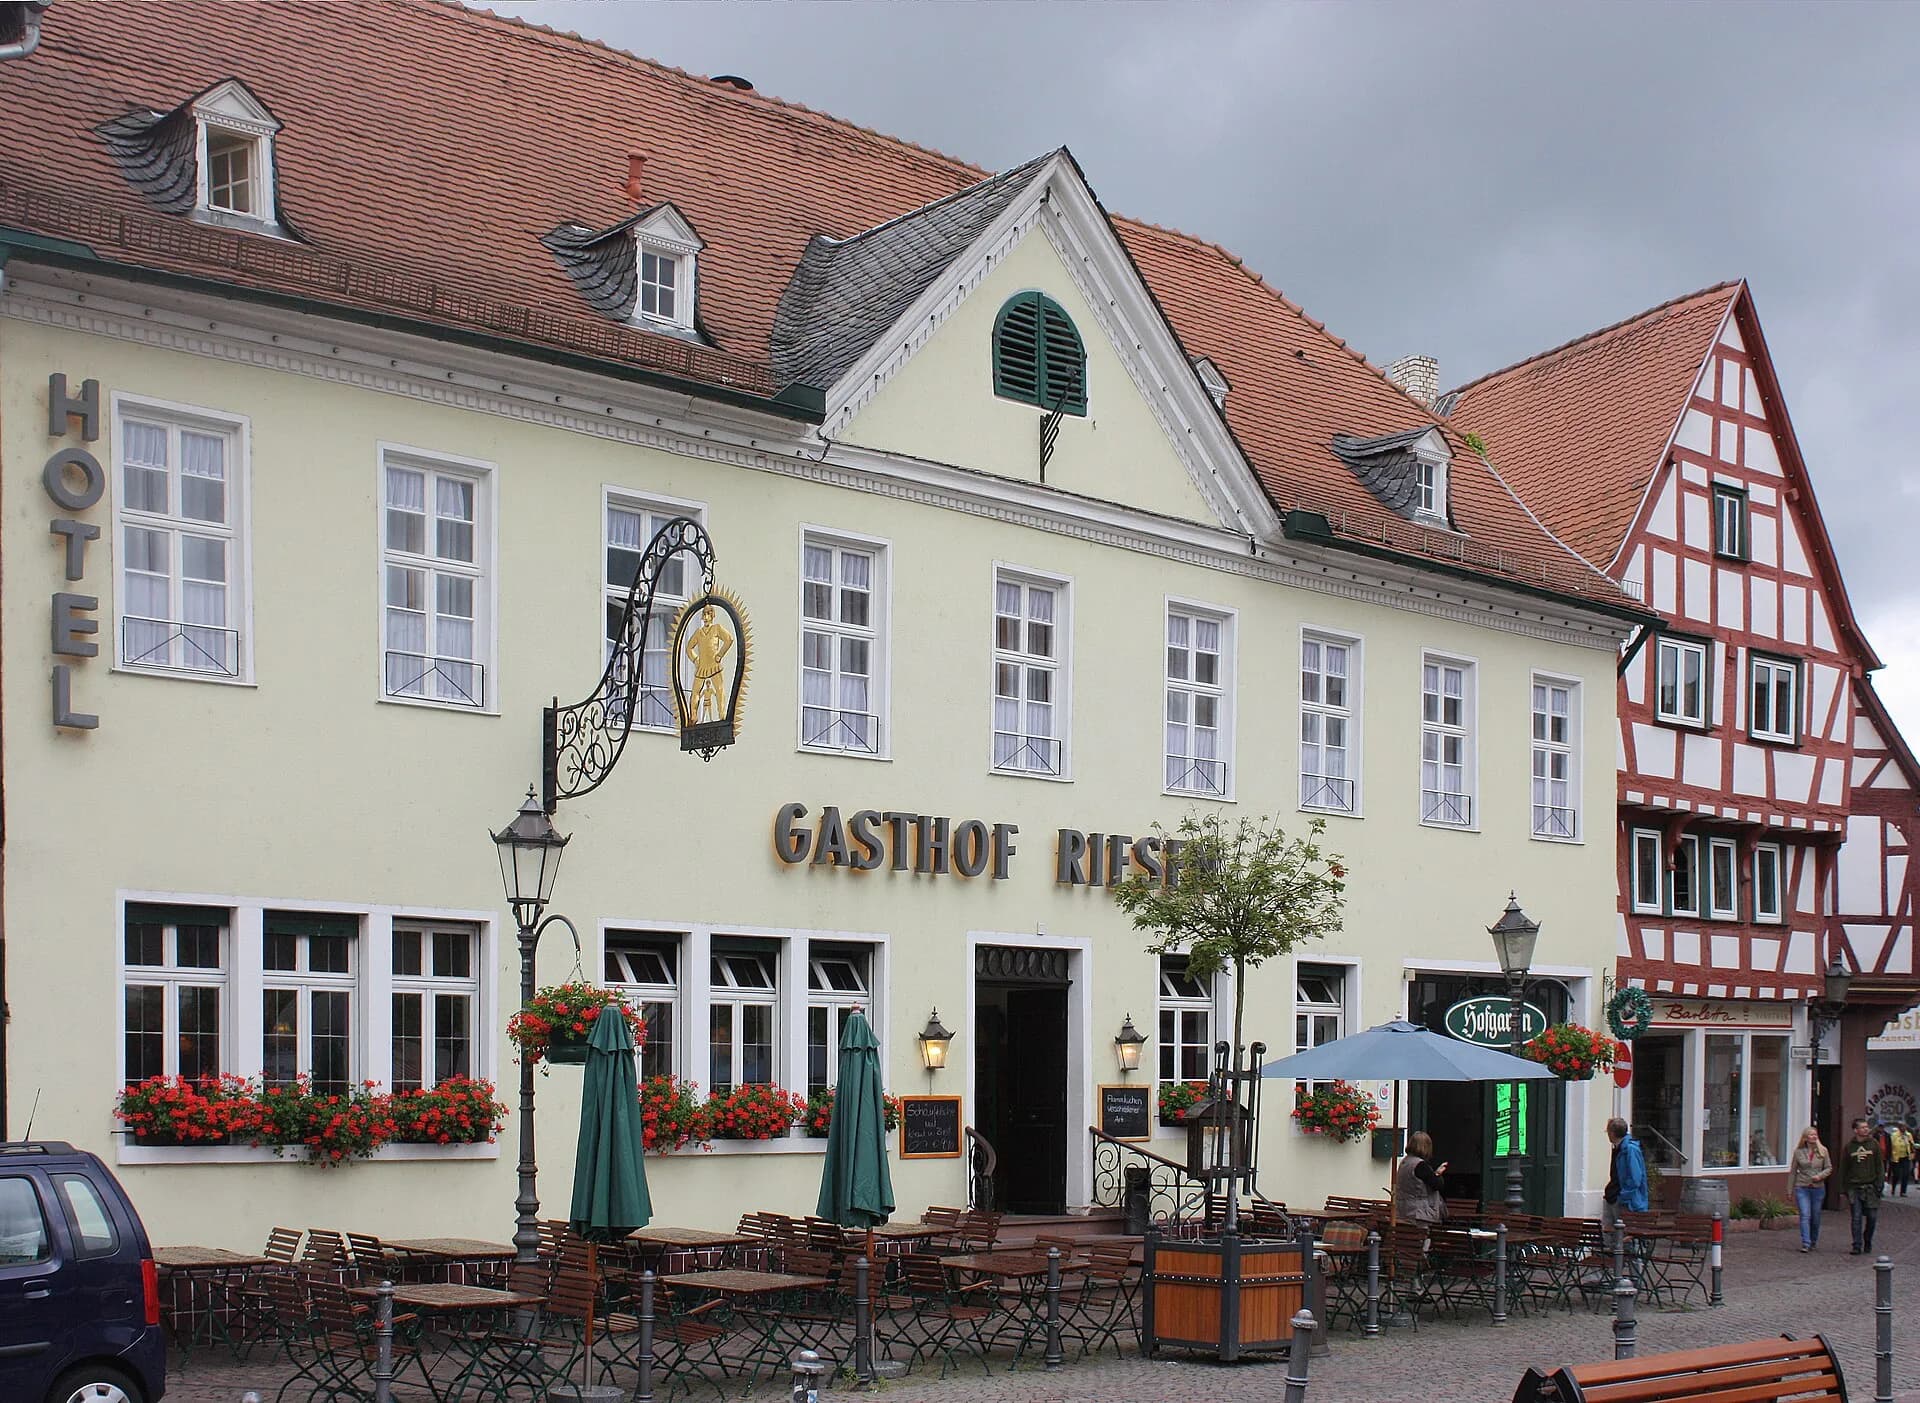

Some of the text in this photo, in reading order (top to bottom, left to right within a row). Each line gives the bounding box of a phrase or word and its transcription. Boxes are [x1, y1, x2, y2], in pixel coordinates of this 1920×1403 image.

[43, 373, 105, 729] HOTEL
[774, 802, 1217, 890] GASTHOF RIESE
[1462, 1004, 1533, 1039] Hofgarn
[1662, 1003, 1737, 1021] Barletta
